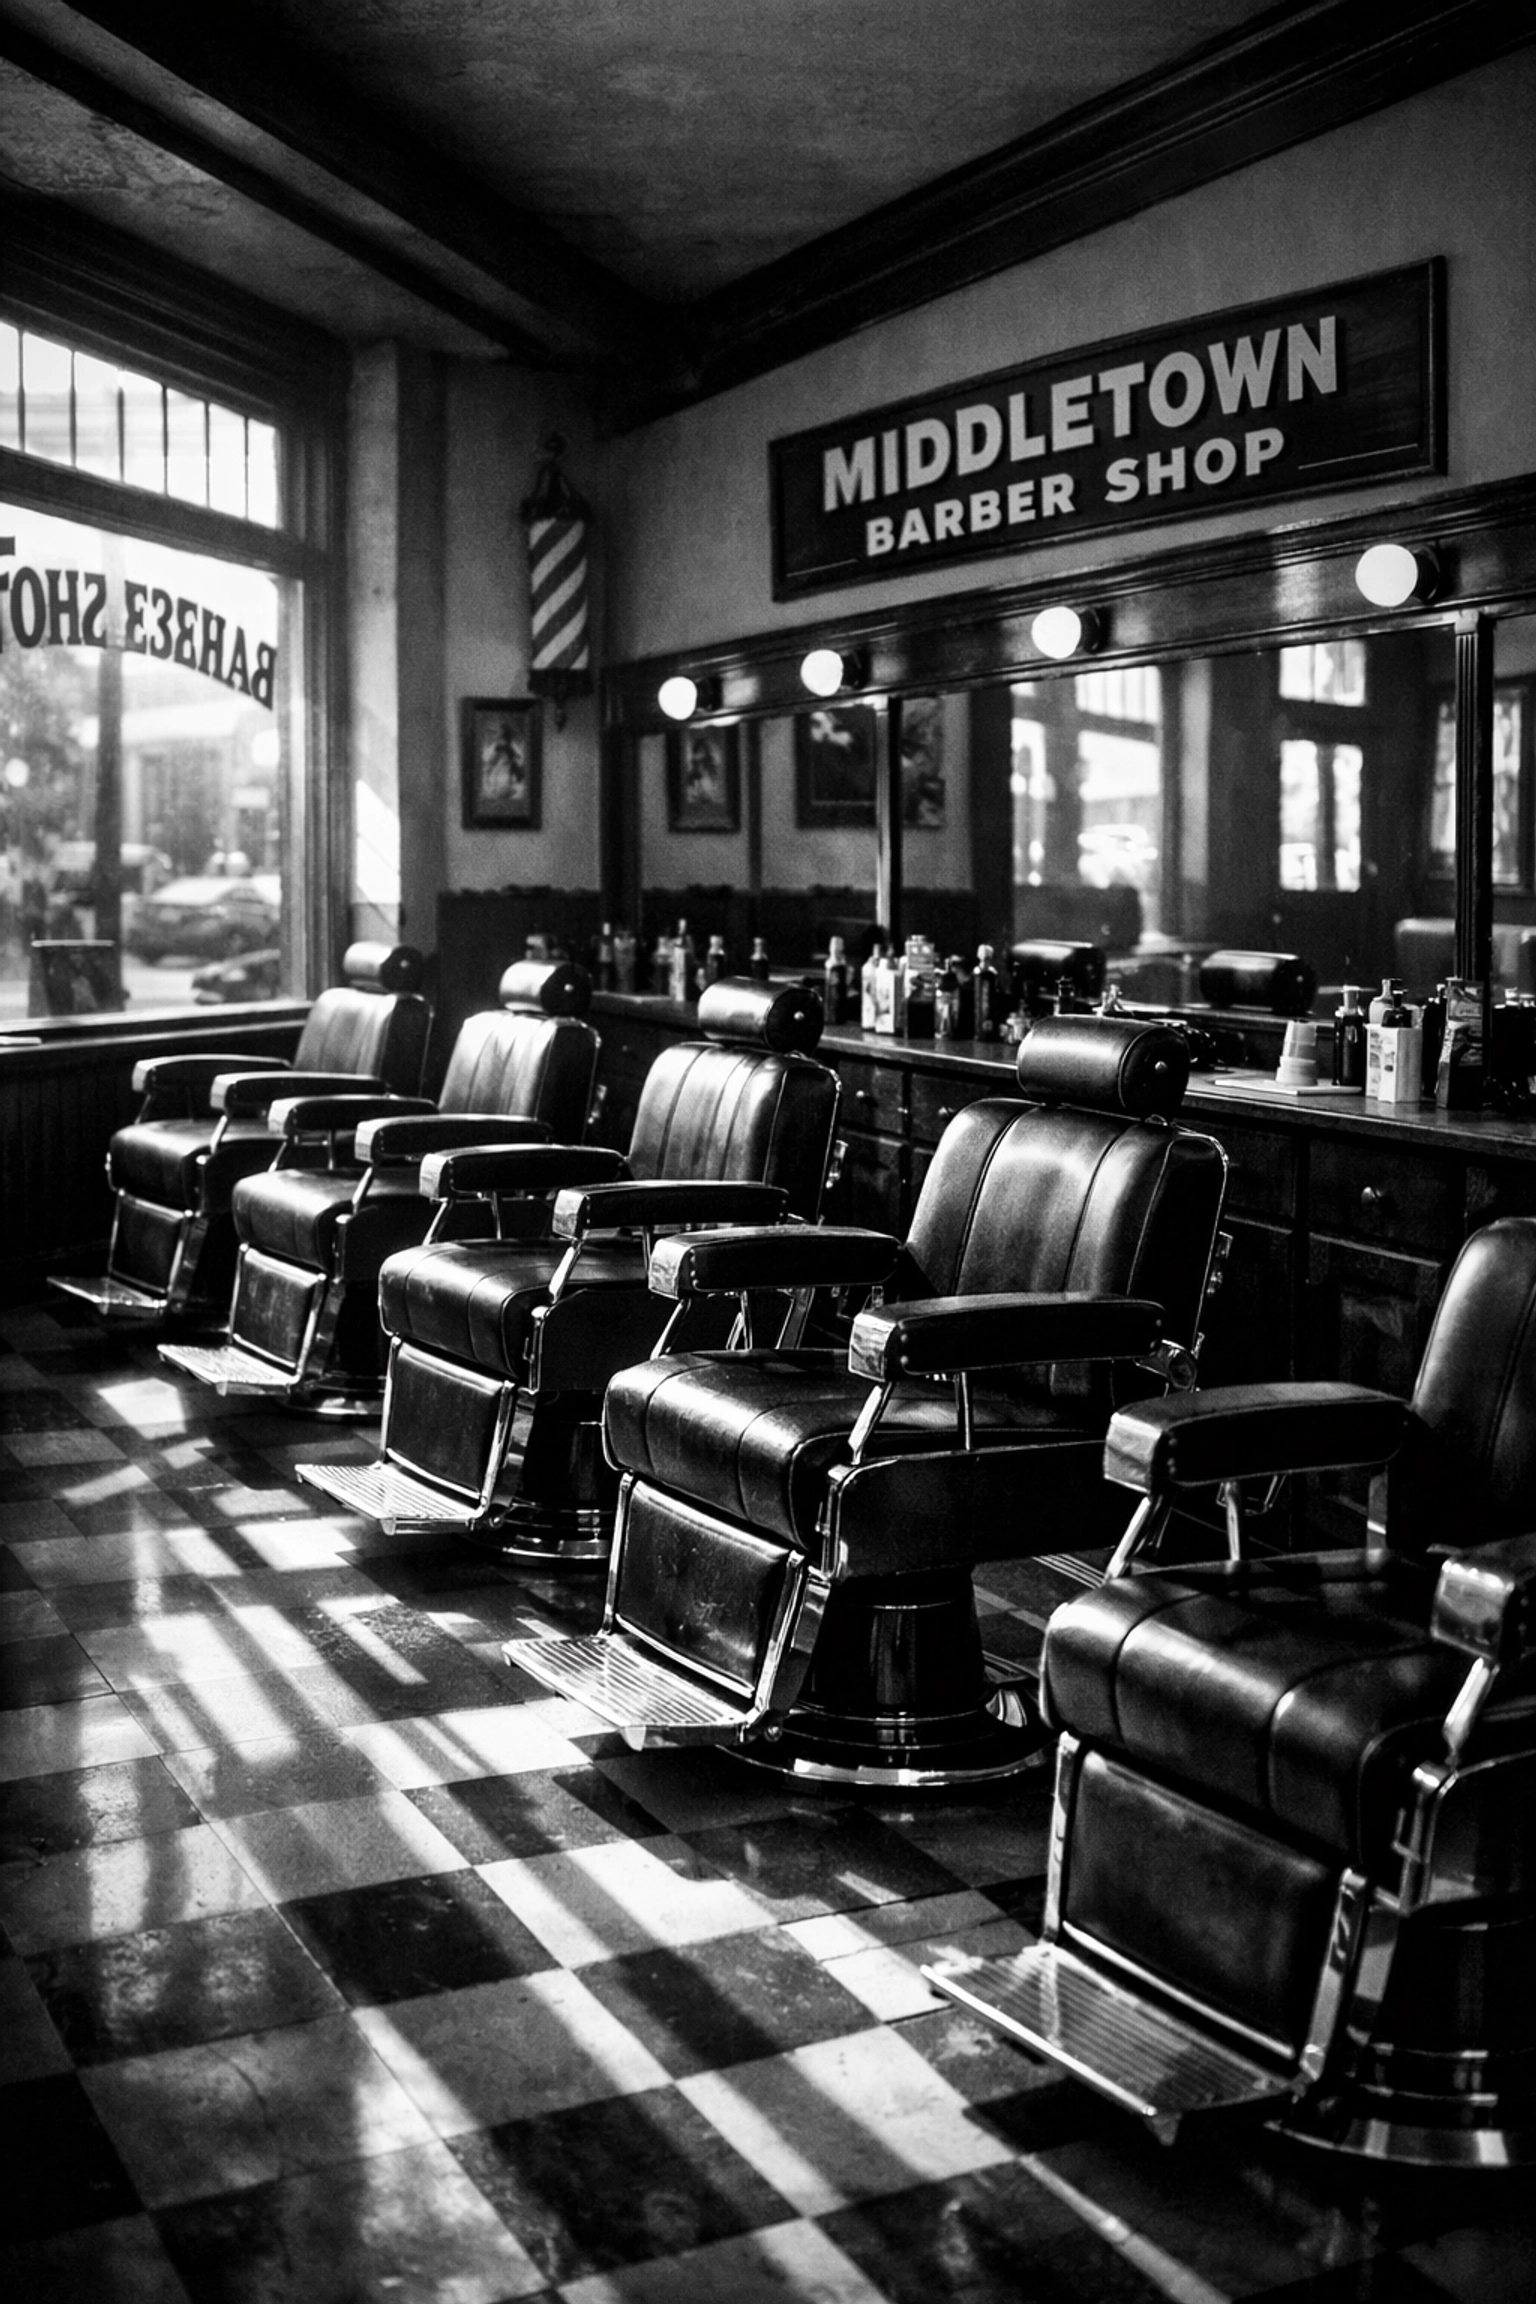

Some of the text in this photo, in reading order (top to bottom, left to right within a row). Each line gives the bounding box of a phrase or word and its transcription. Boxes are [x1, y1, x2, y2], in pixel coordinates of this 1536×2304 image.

[824, 315, 1337, 511] MIDDLETOWN
[866, 428, 1284, 557] BARBER SHOP
